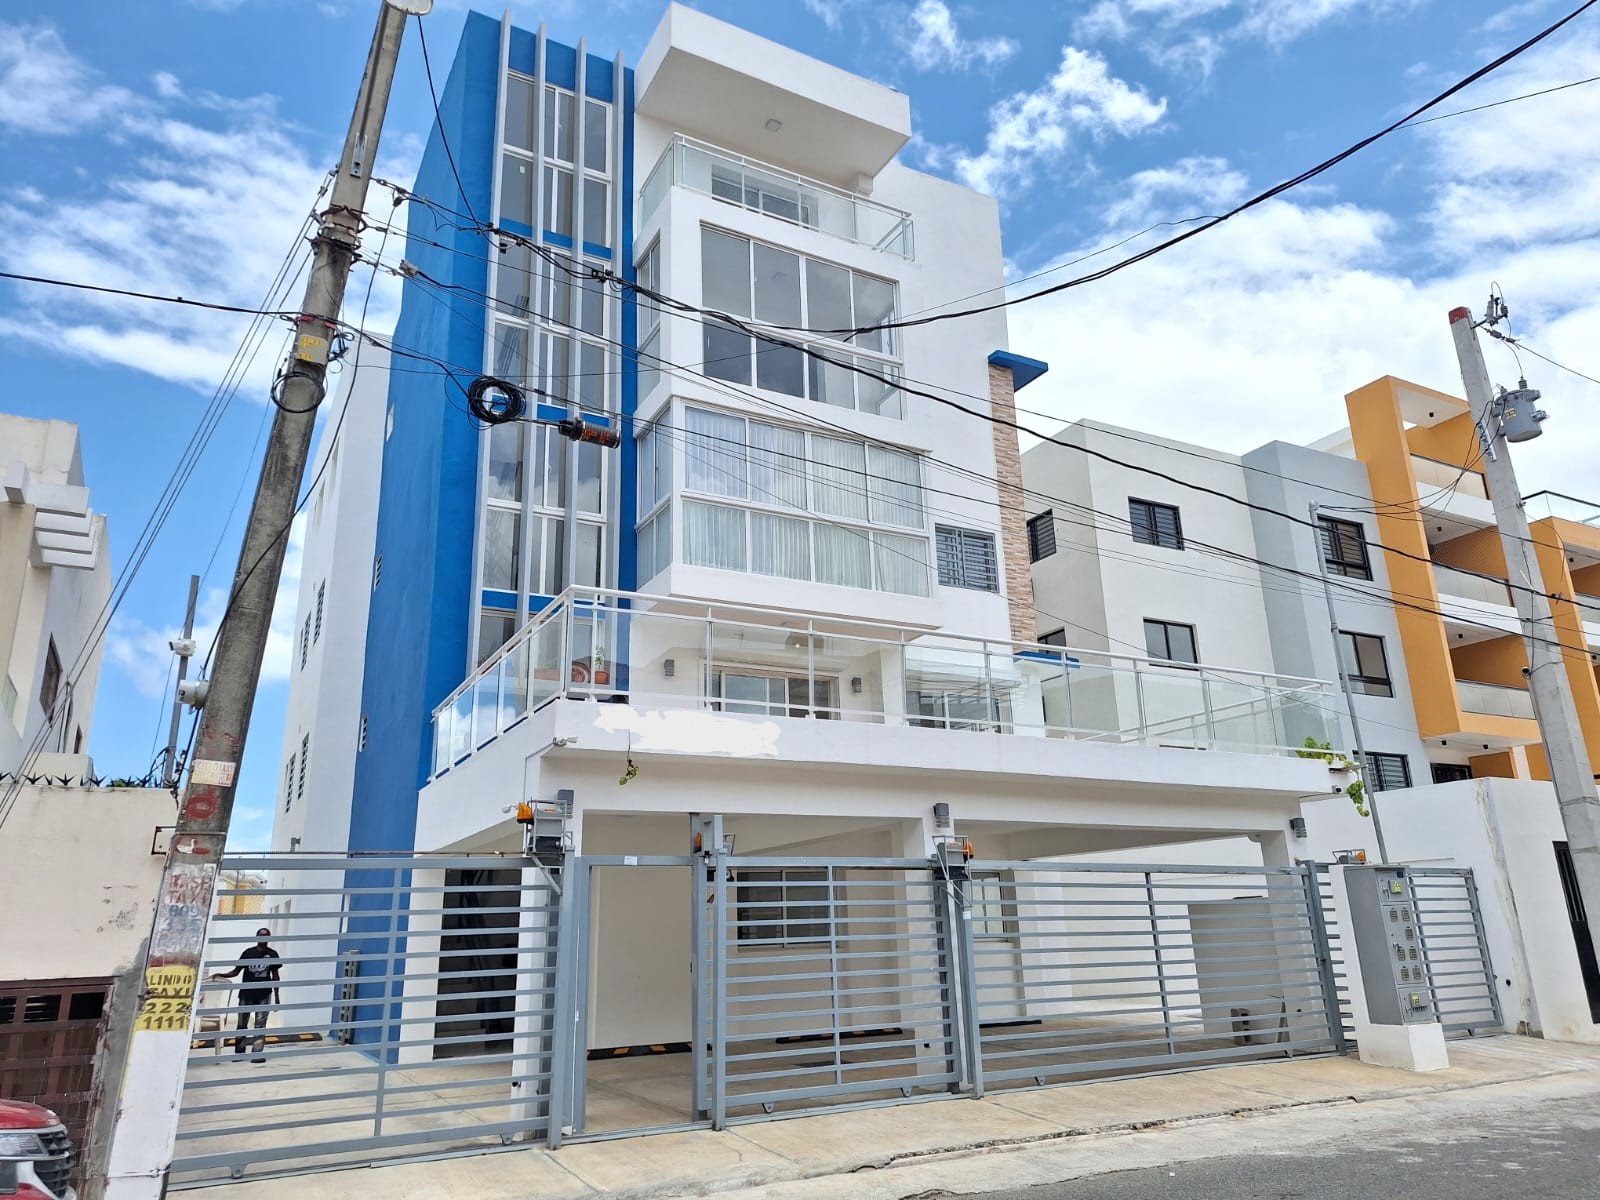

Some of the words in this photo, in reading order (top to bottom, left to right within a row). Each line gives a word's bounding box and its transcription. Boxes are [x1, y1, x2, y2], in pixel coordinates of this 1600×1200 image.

[168, 889, 208, 906] TAXI
[143, 1002, 189, 1014] 222
[143, 1016, 186, 1030] 1111
